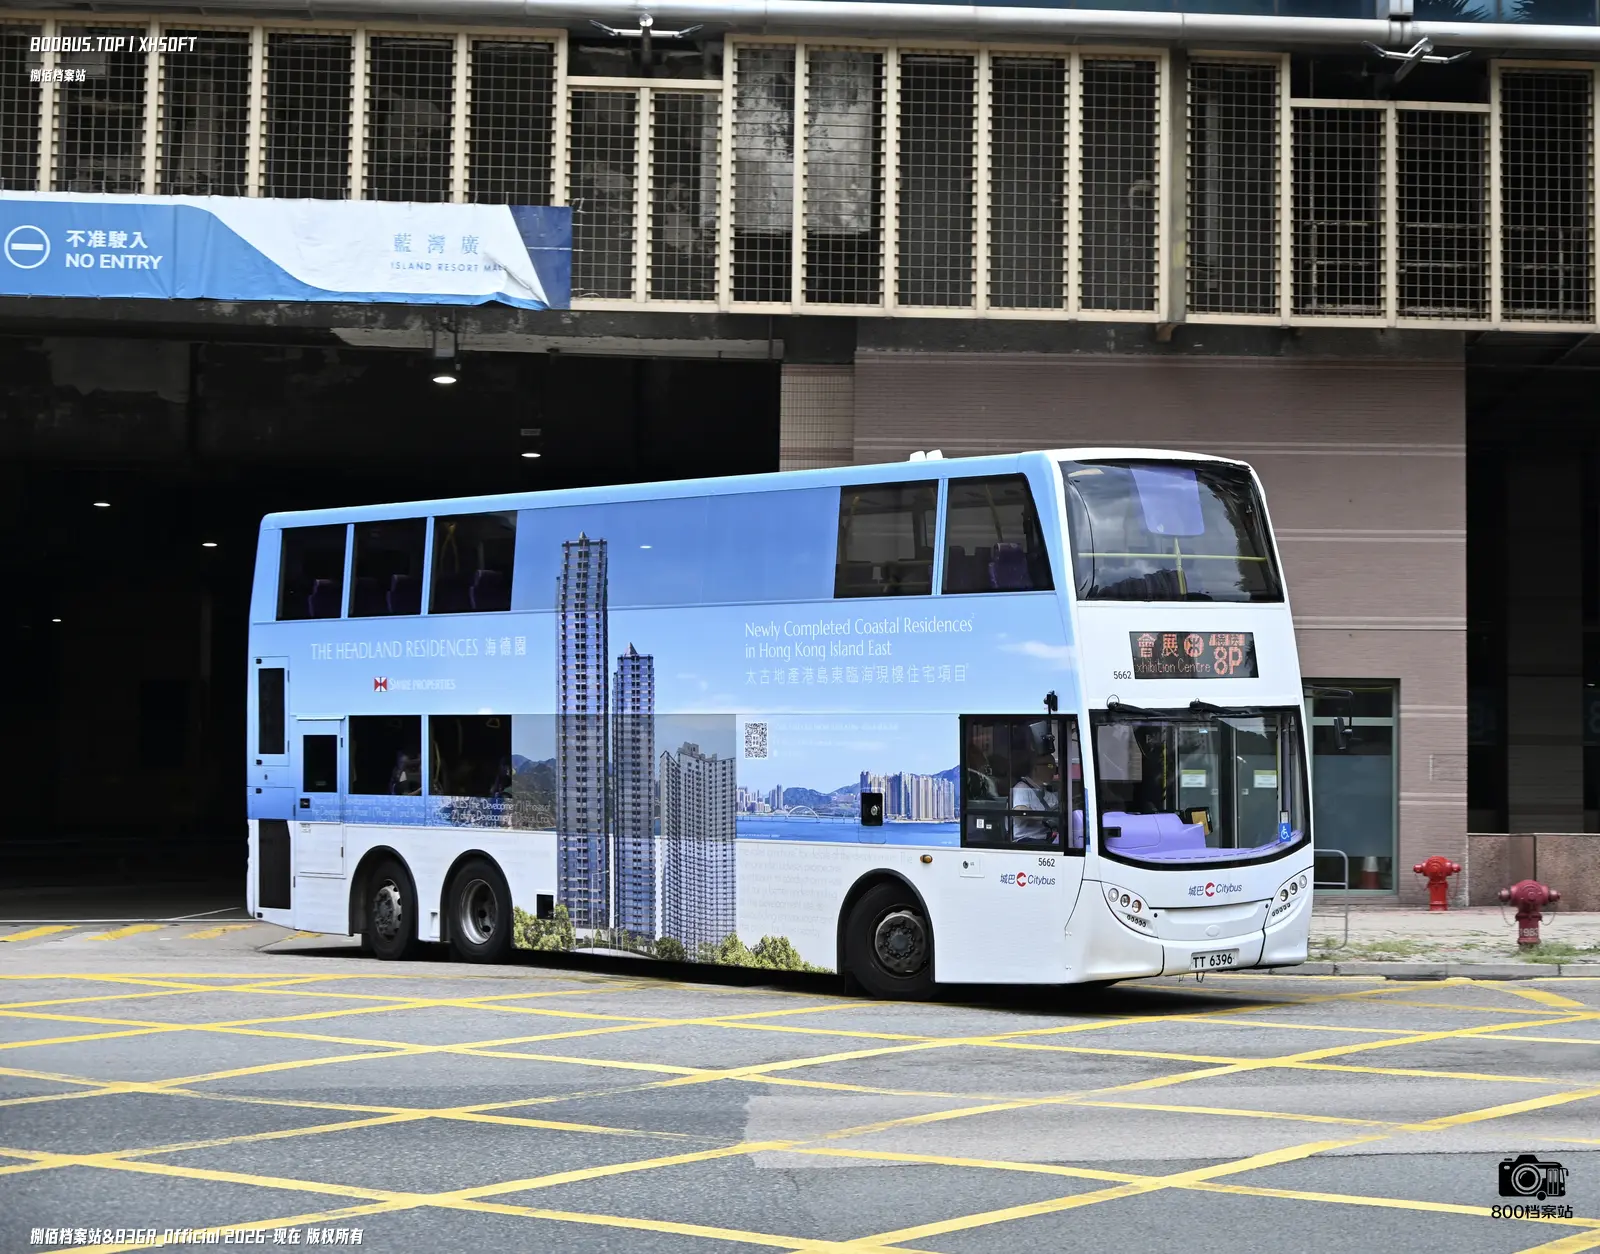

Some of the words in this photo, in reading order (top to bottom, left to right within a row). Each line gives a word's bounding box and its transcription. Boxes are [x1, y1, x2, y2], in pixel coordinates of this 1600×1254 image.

[66, 230, 148, 249] 不准駛入
[394, 233, 480, 255] 藍灣廣
[65, 253, 95, 268] NO
[100, 254, 163, 270] ENTRY
[391, 261, 432, 271] ISLAND
[438, 263, 478, 272] RESORT
[745, 621, 780, 640] Newly
[784, 619, 850, 640] Completed
[311, 643, 333, 660] THE
[336, 641, 402, 659] HEADLAND
[406, 639, 478, 657] RESIDENCES
[485, 636, 526, 656] 海德園
[745, 643, 755, 658] in
[759, 643, 791, 662] Hong
[795, 642, 826, 661] Kong
[830, 639, 864, 657] Island
[868, 640, 892, 656] East
[1137, 633, 1179, 657] 會展
[1135, 659, 1175, 673] xhibition
[1178, 658, 1211, 673] Centre
[1214, 646, 1243, 675] 8P
[1114, 670, 1132, 680] 5662
[1038, 858, 1055, 867] 5662
[1000, 874, 1015, 884] 城巴
[1027, 874, 1056, 886] Citybus
[1188, 885, 1204, 896] 城巴
[1215, 883, 1242, 894] Citybus
[1193, 956, 1206, 968] TT
[1209, 953, 1233, 967] 6396
